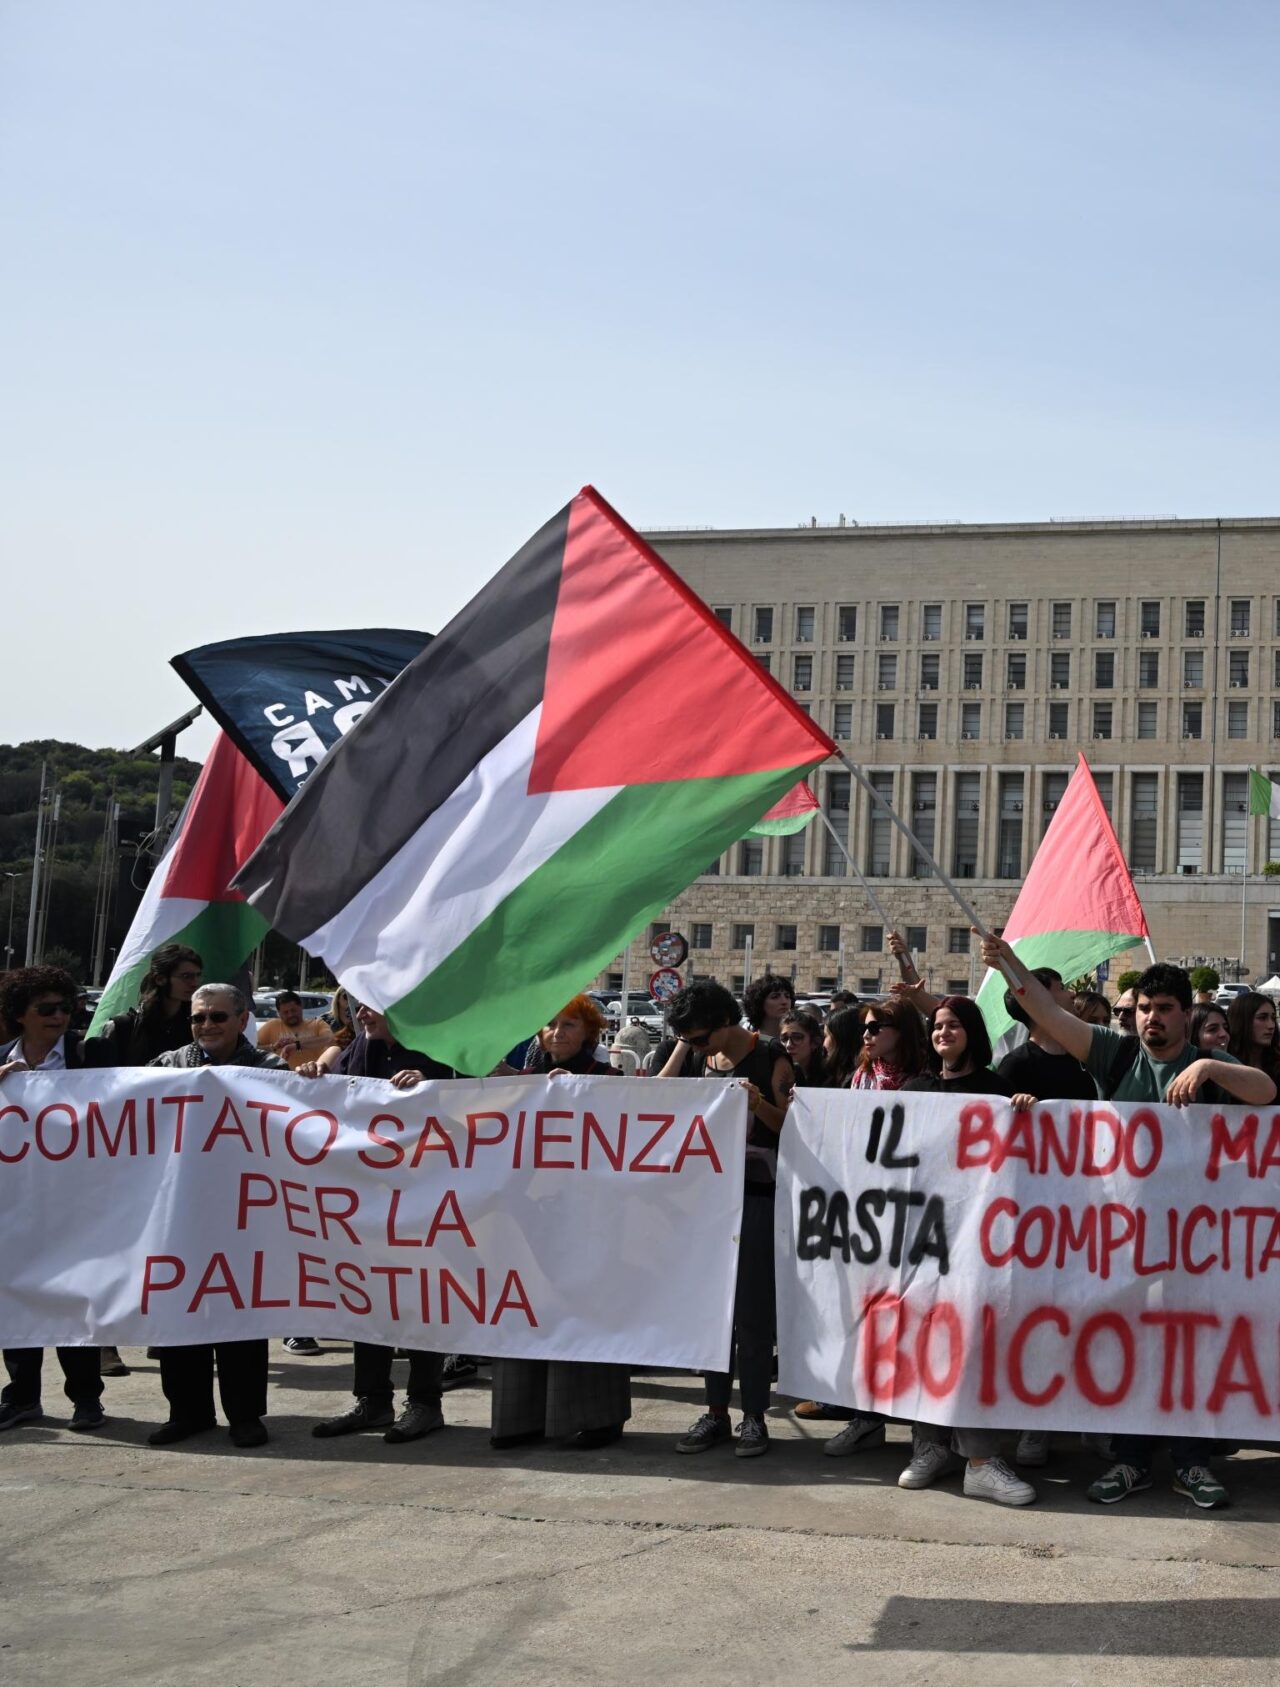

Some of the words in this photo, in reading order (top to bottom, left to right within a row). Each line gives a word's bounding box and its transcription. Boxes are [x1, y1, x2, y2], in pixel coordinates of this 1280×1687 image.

[0, 1095, 339, 1166] COMITATO
[358, 1109, 723, 1174] SAPIENZA
[865, 1104, 920, 1169] IL
[955, 1100, 1163, 1179] BANDO
[236, 1172, 361, 1246] PER
[386, 1189, 476, 1248] LA
[797, 1186, 952, 1276] BASTA
[140, 1250, 540, 1328] PALESTINA
